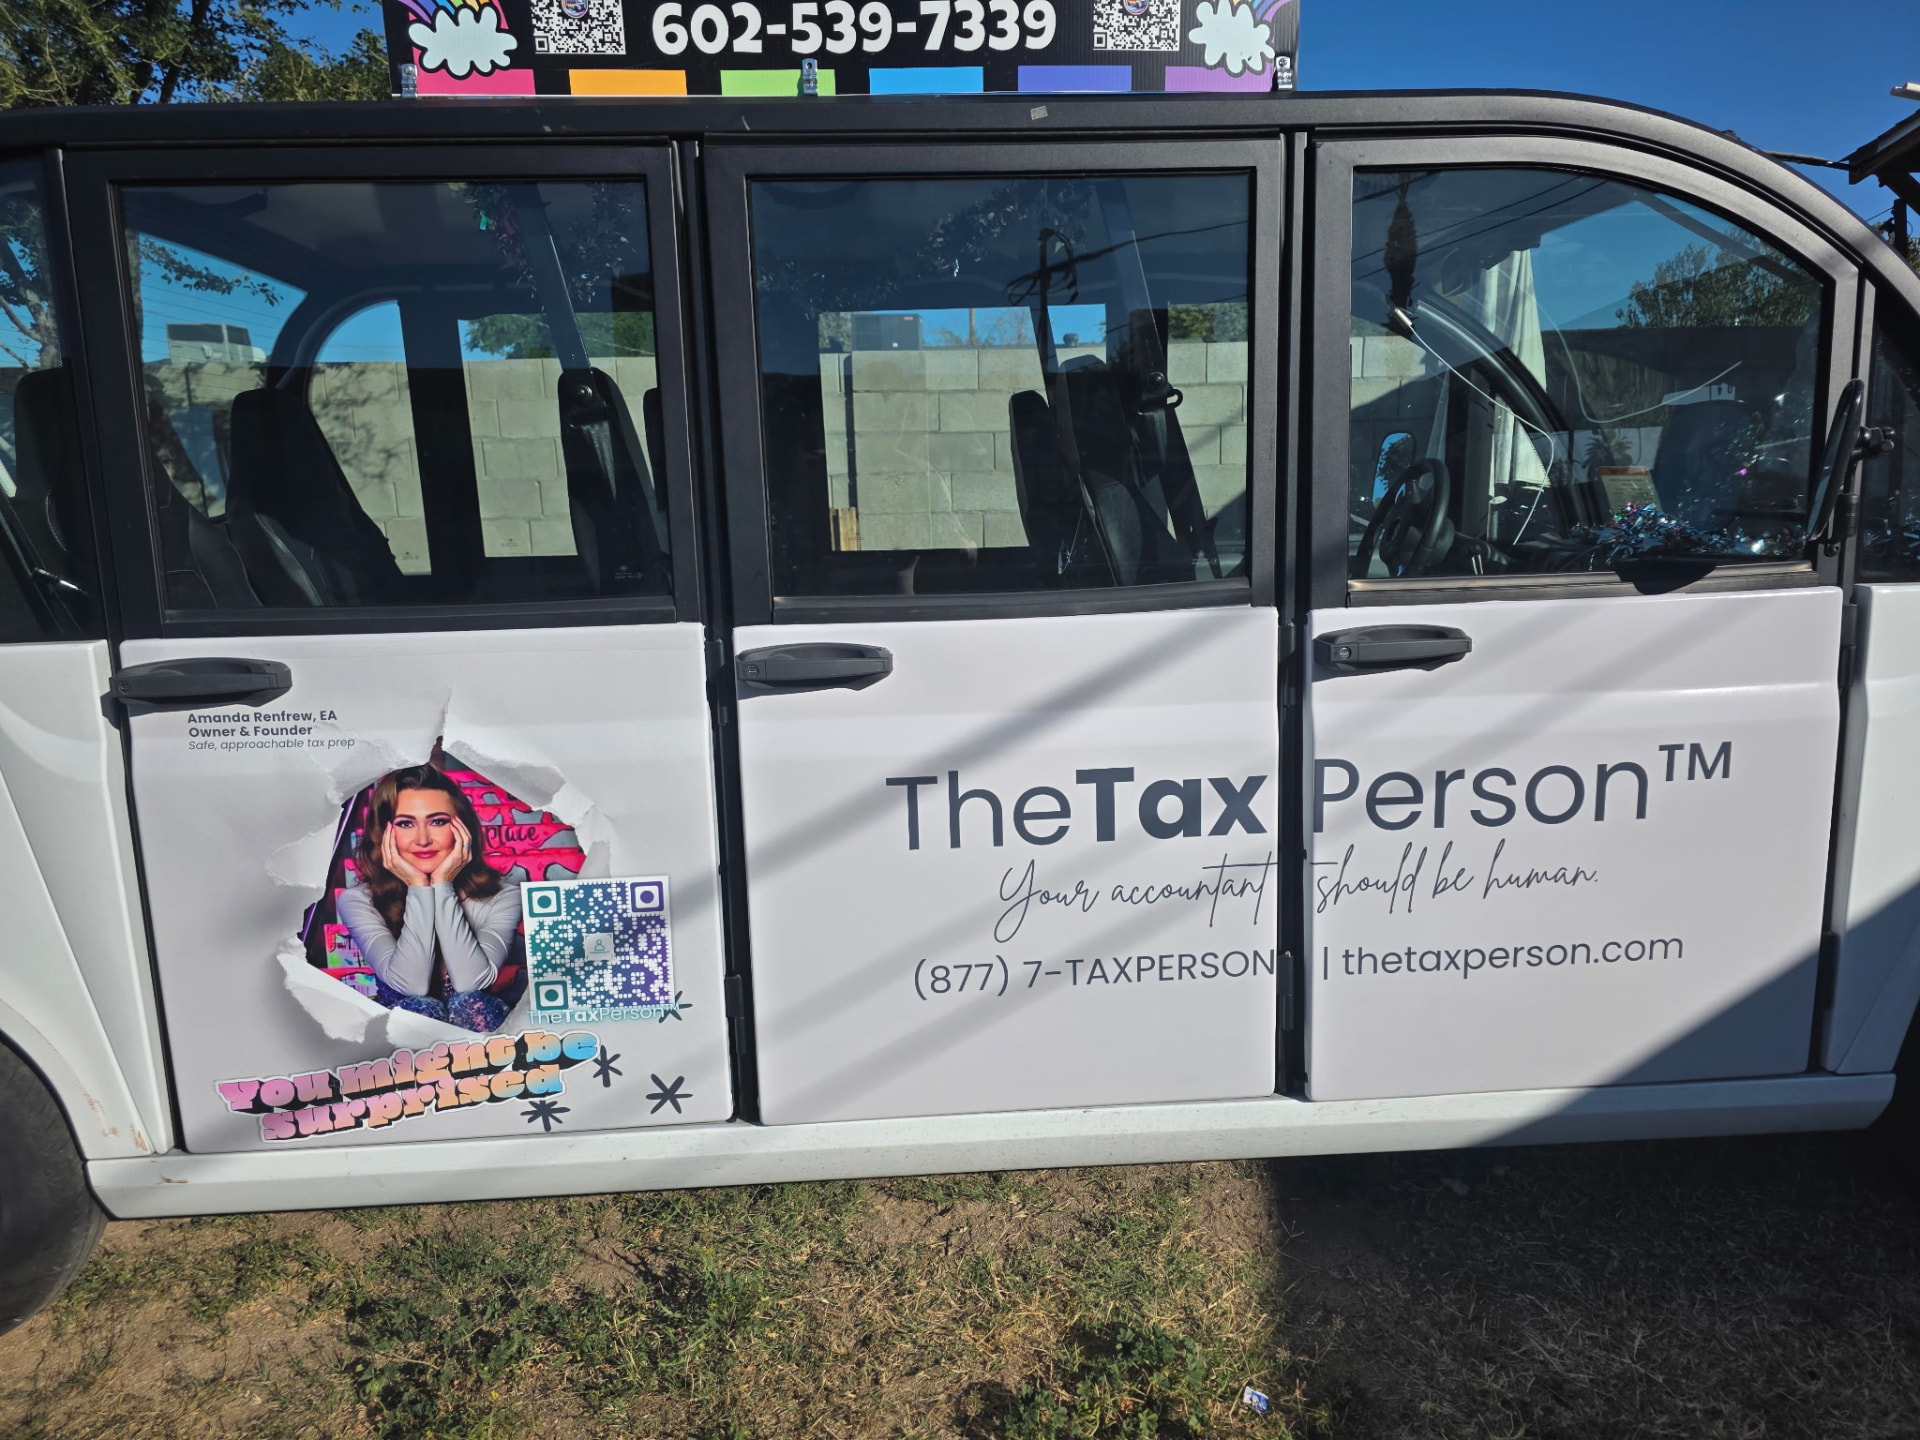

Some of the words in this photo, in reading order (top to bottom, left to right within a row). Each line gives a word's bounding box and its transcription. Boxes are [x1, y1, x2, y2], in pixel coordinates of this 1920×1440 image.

[652, 0, 1057, 55] 602-539-7339
[187, 712, 250, 724] Amanda
[253, 710, 317, 723] Renfrew,
[320, 710, 337, 721] EA
[188, 727, 236, 738] Owner
[239, 727, 250, 737] &
[253, 725, 312, 736] Founder
[188, 740, 217, 751] Safe,
[220, 738, 304, 752] approachable
[307, 738, 325, 748] tax
[327, 737, 356, 750] prep
[994, 859, 1100, 943] Your
[1111, 851, 1279, 927] accountant
[1316, 843, 1428, 914] should
[1432, 840, 1475, 899] be
[1483, 838, 1599, 899] human.
[914, 955, 1008, 1000] (877)
[1023, 949, 1275, 989] 7-TAXPERSON
[1342, 937, 1684, 979] thetaxperson.com
[339, 1037, 518, 1096] might
[522, 1031, 598, 1068] be
[262, 1064, 563, 1140] surprised
